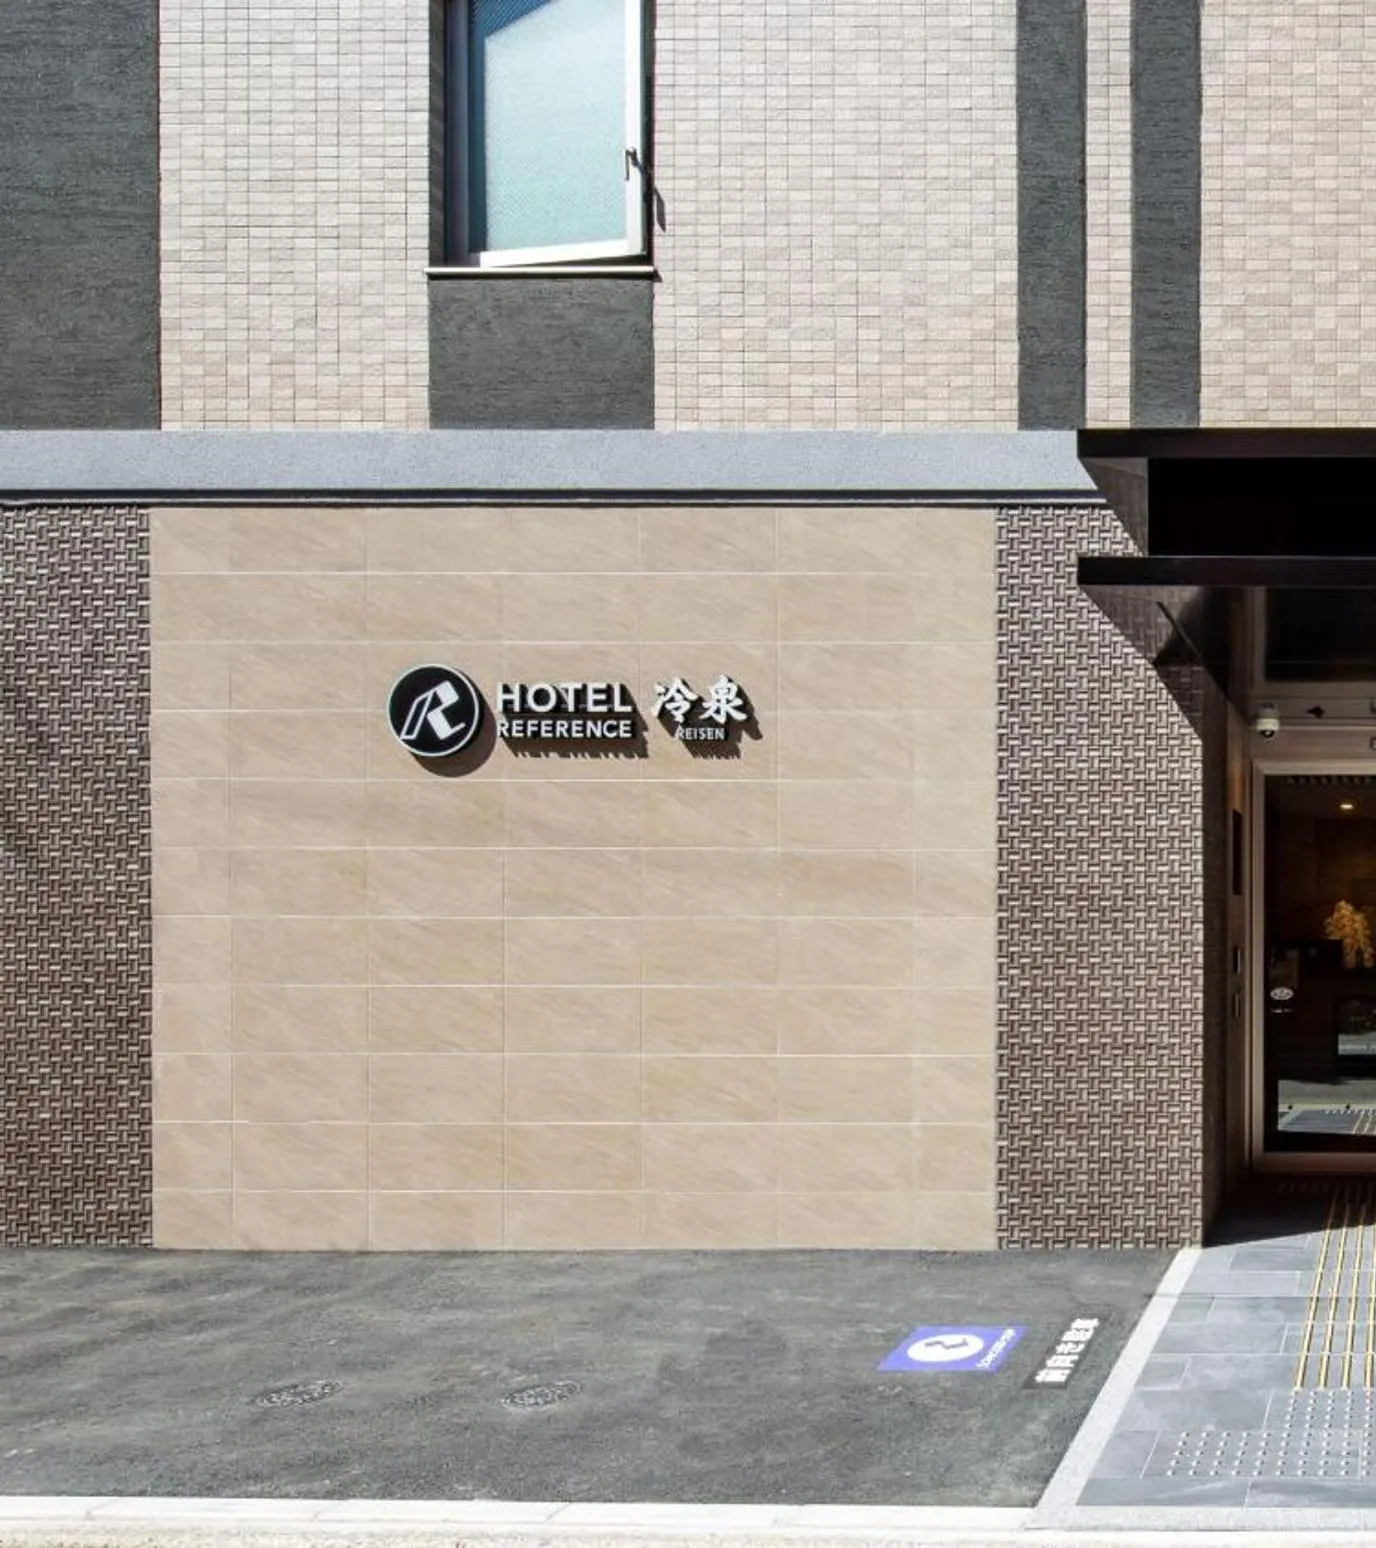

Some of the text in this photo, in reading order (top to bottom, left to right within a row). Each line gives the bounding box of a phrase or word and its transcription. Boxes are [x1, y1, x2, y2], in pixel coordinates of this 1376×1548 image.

[496, 682, 632, 713] HOTEL
[652, 674, 747, 724] 冷泉
[497, 720, 632, 738] REFERENCE
[677, 727, 725, 740] REISEN
